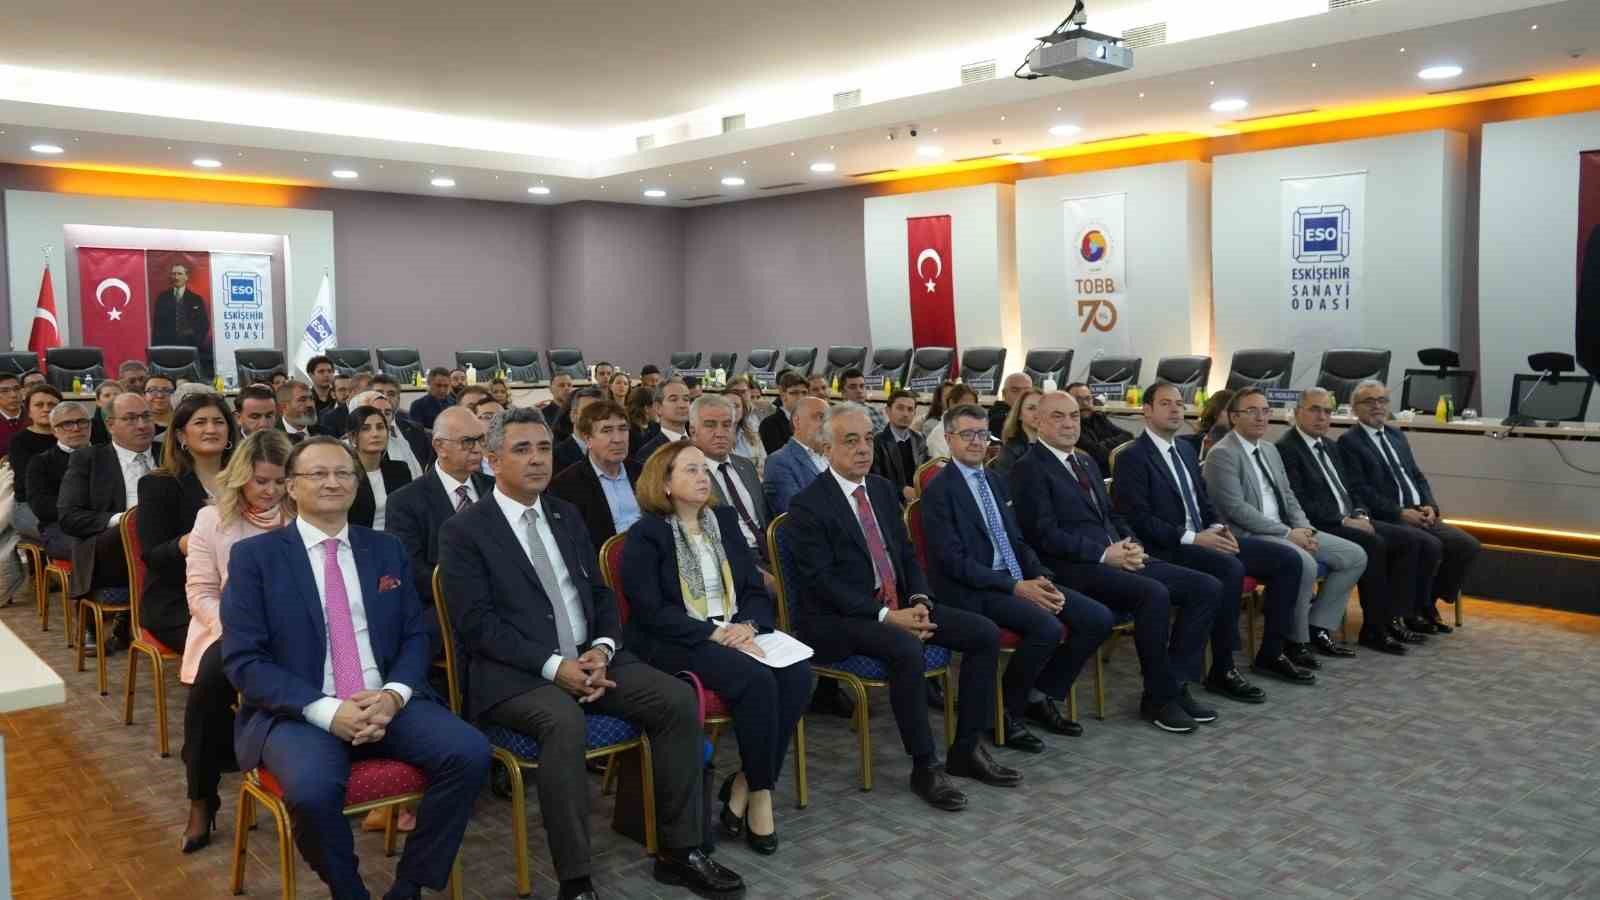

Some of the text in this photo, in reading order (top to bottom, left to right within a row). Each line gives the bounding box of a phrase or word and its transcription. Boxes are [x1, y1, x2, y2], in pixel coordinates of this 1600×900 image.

[1305, 227, 1337, 242] ESO
[1292, 264, 1350, 283] ESKİŞEHİR
[231, 286, 253, 295] ESO
[1075, 278, 1115, 294] TOBB
[1292, 298, 1350, 310] ODASI
[1077, 299, 1118, 333] 70
[224, 331, 264, 340] ODASI
[311, 319, 329, 339] ESO
